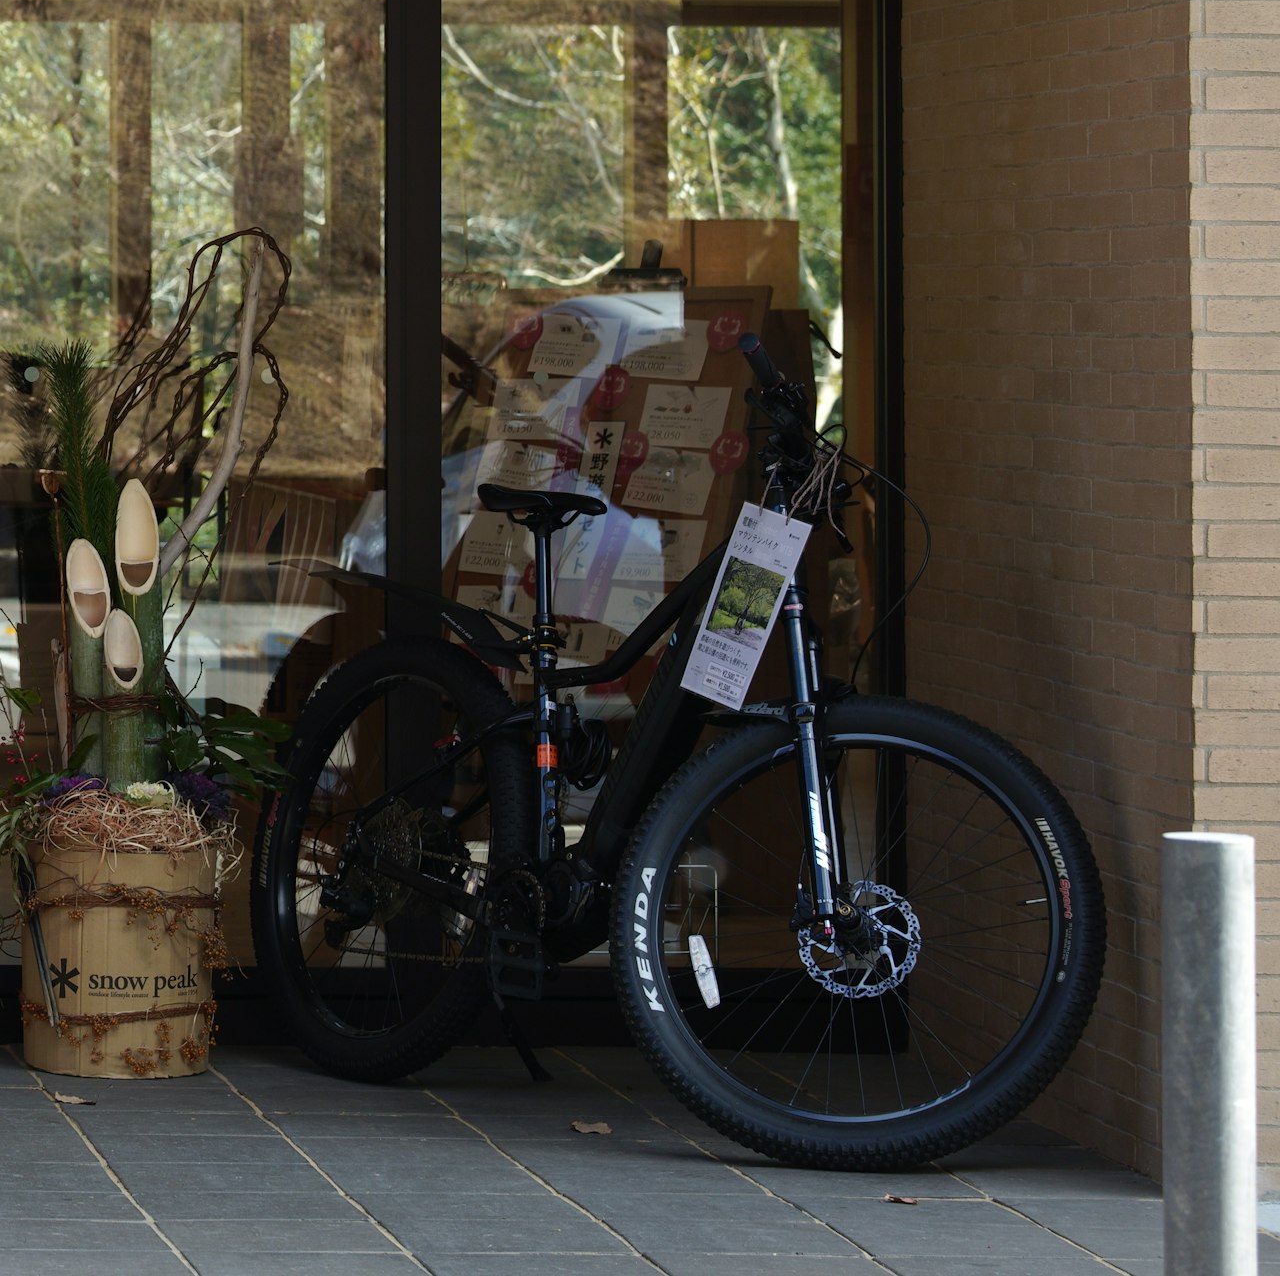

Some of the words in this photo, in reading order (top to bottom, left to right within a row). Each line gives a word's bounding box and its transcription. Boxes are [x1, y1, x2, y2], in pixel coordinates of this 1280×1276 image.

[534, 356, 575, 368] ¥198,000
[573, 452, 610, 575] 野遊セット
[627, 489, 665, 504] ¥22,000
[738, 530, 780, 551] マウンテンバイク
[465, 554, 501, 568] ¥22,000
[1041, 831, 1070, 880] HAVOK
[1058, 879, 1073, 920] Sport
[633, 867, 666, 1013] KENDA
[88, 973, 150, 991] snow
[149, 964, 198, 998] peak
